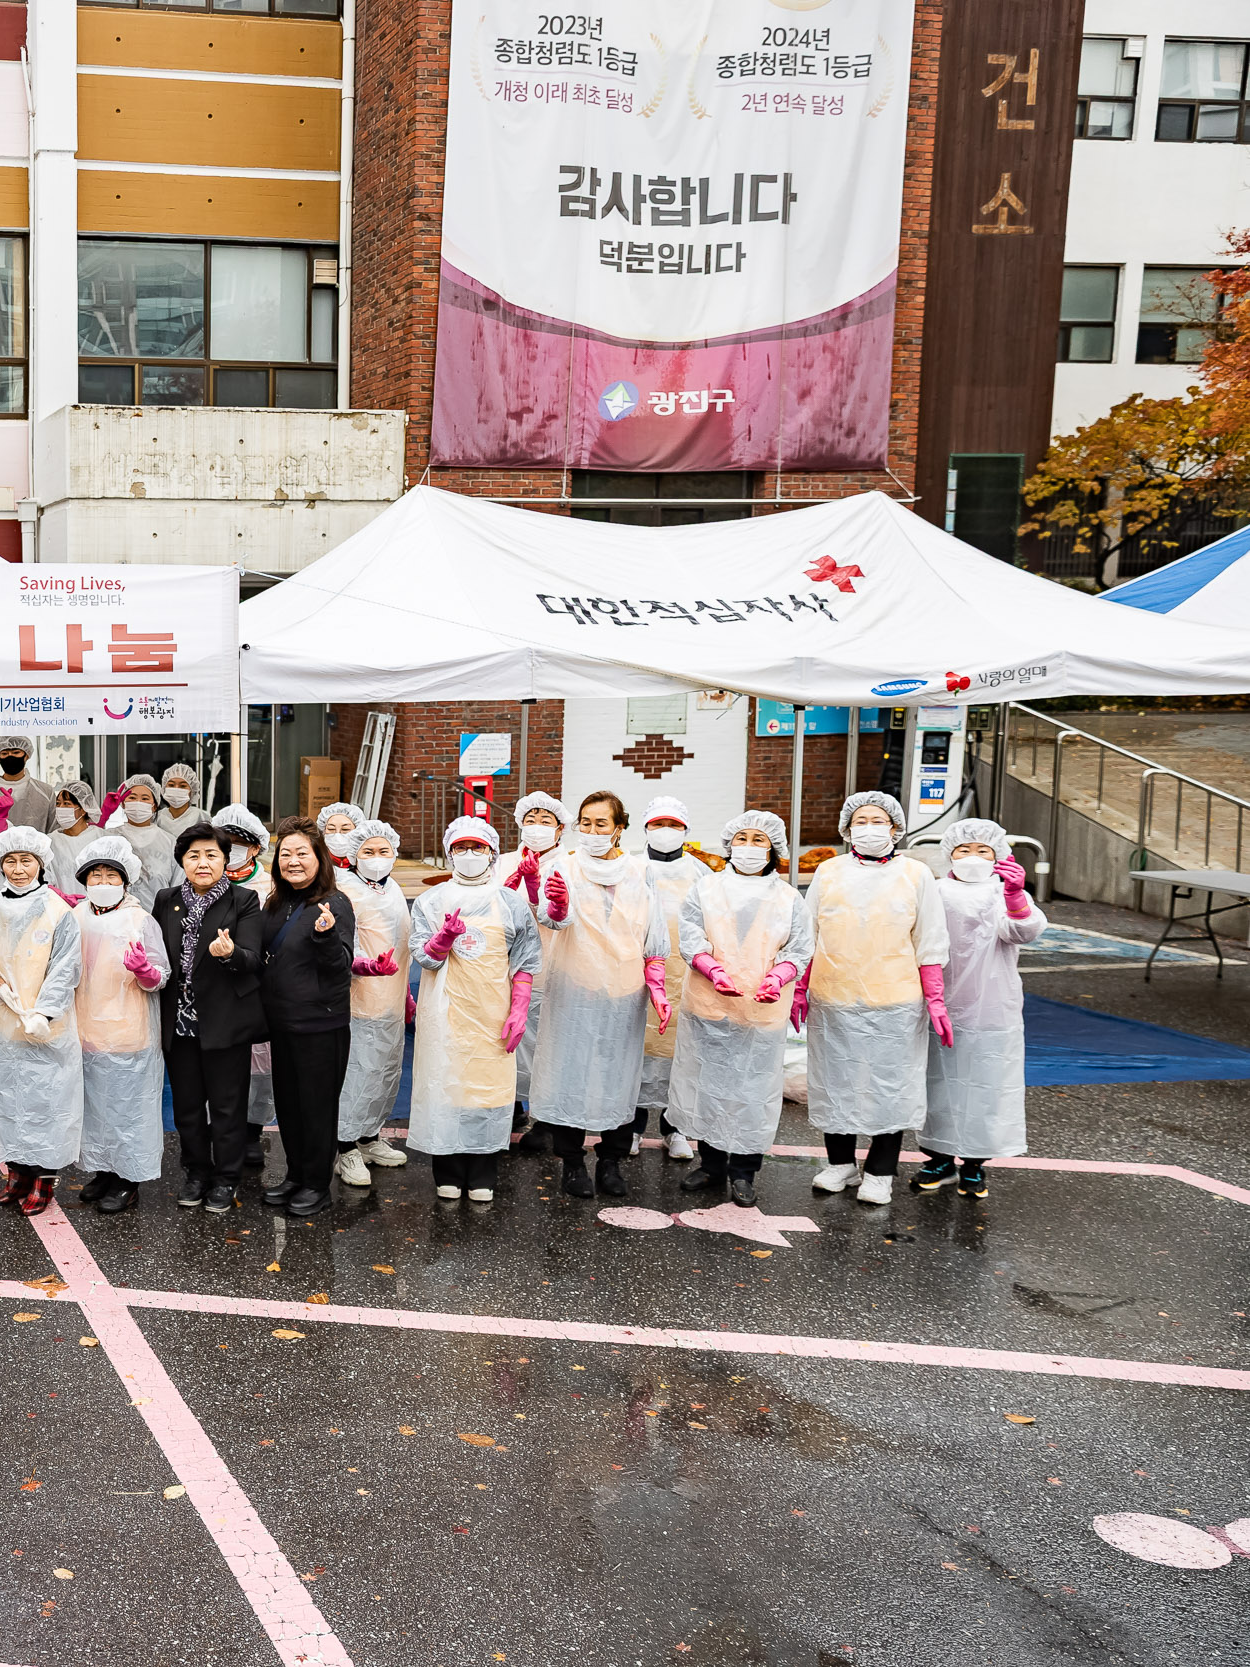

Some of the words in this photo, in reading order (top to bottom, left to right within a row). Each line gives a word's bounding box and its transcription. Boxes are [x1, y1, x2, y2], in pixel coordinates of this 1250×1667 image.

[537, 15, 603, 41] 2023년
[762, 27, 830, 51] 2024년
[494, 38, 592, 65] 종합청렴도
[597, 47, 638, 77] 1등급
[716, 52, 817, 79] 종합청렴도
[823, 54, 872, 79] 1등급
[494, 80, 528, 103] 개청
[534, 82, 568, 103] 이래
[572, 83, 601, 105] 최초
[605, 88, 633, 113] 달성
[741, 92, 768, 113] 2년
[773, 92, 807, 114] 연속
[811, 95, 844, 116] 달성
[558, 165, 798, 227] 감사합니다
[599, 239, 747, 274] 덕분입니다
[648, 389, 735, 416] 광진구
[20, 576, 75, 593] Saving
[81, 576, 126, 592] Lives,
[20, 594, 63, 606] 적십자는
[67, 594, 125, 606] 생명입니다.
[536, 592, 839, 626] 대한적십자사
[18, 622, 178, 674] 나눔
[876, 681, 923, 692] SAMSUNG
[979, 669, 1015, 687] 사랑의
[1018, 666, 1047, 684] 열매
[32, 717, 78, 726] Association
[139, 706, 174, 719] 행복광진
[929, 788, 944, 798] 117
